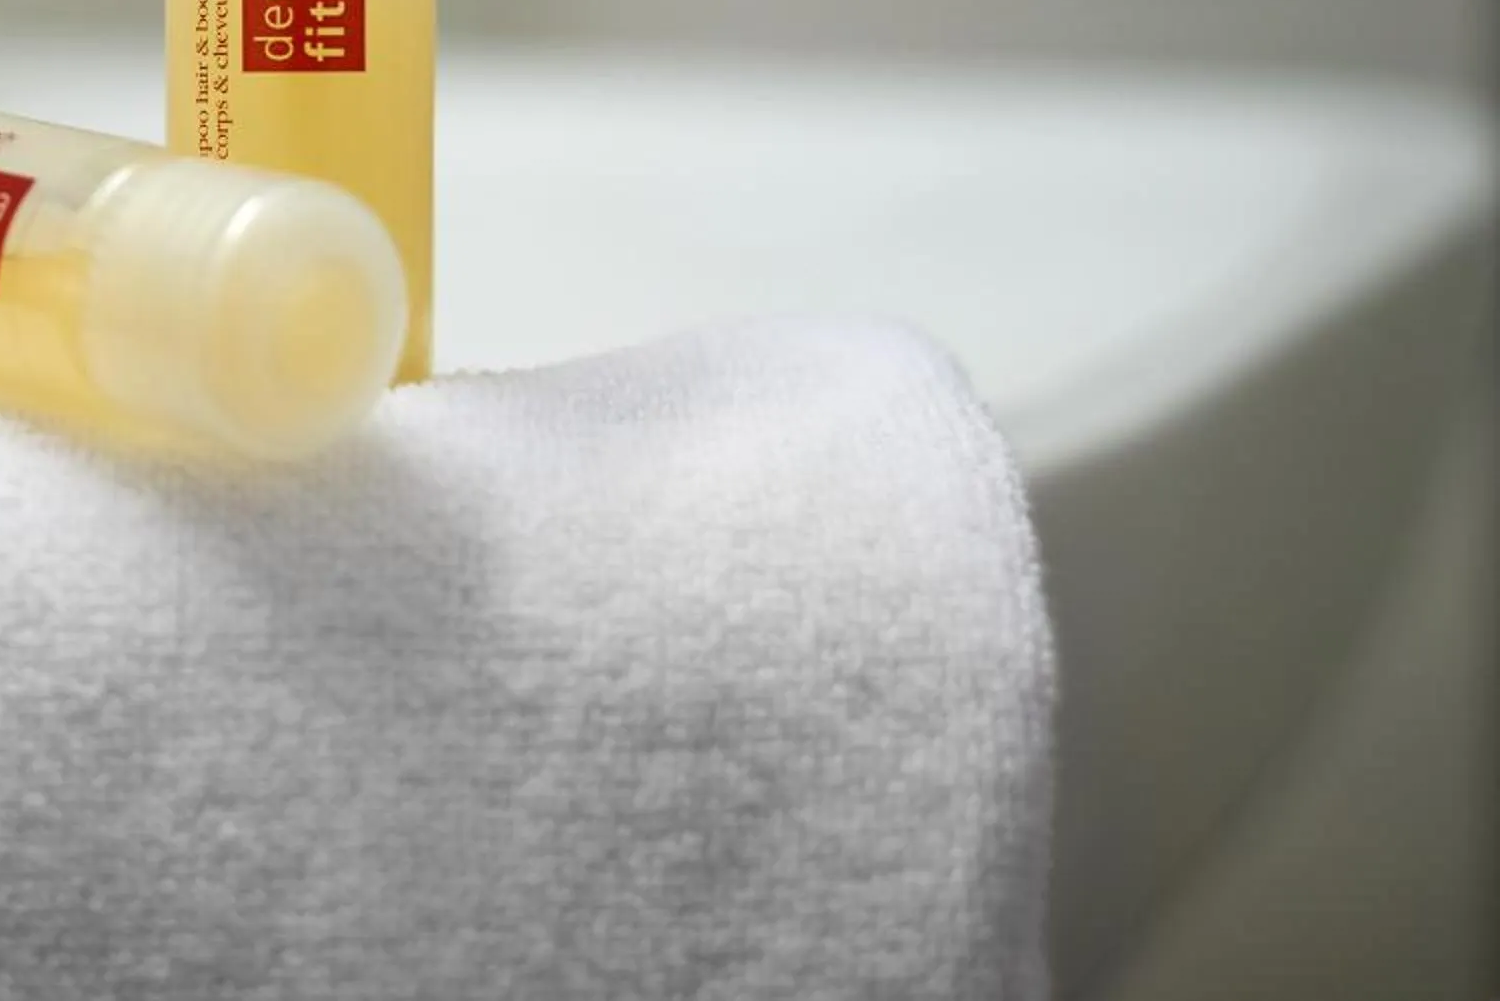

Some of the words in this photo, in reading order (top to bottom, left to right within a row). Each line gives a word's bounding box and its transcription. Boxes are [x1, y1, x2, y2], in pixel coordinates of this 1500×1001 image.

[195, 35, 208, 56] &
[304, 0, 345, 62] fit
[195, 61, 208, 103] hair
[213, 75, 228, 94] &
[216, 100, 233, 160] corps
